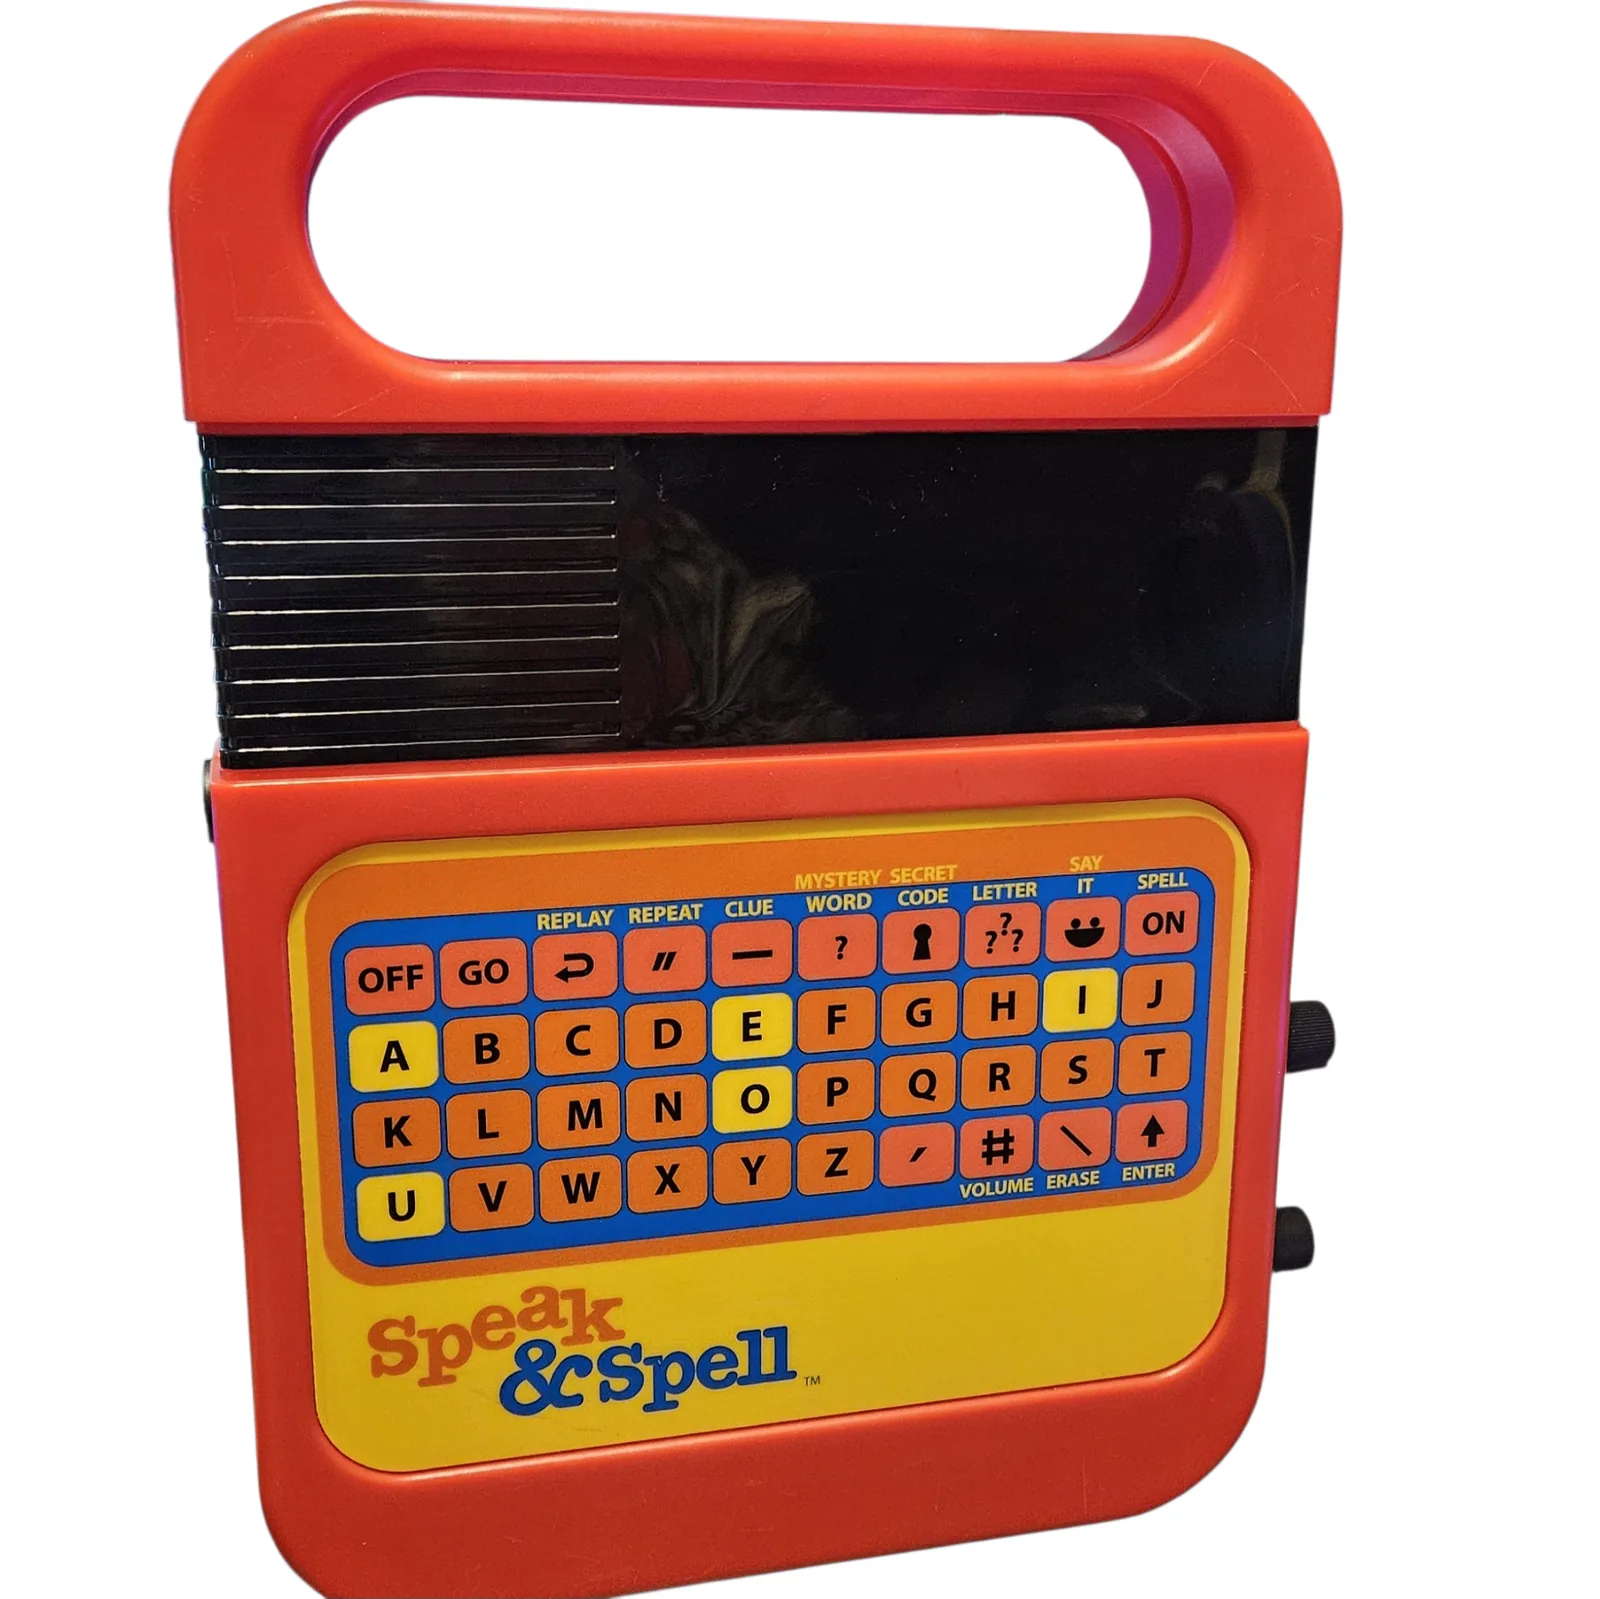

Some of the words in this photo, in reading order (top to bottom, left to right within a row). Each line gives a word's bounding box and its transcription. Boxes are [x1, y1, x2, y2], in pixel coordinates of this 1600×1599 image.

[1069, 855, 1103, 872] SAY
[795, 870, 881, 890] MYSTERY
[890, 865, 957, 883] SECRET
[1137, 873, 1188, 890] SPELL
[972, 883, 1037, 902] LETTER
[1077, 878, 1094, 894] IT
[806, 893, 872, 913] WORD
[898, 888, 949, 906] CODE
[629, 904, 703, 923] REPEAT
[725, 900, 774, 917] CLUE
[537, 910, 614, 930] REPLAY
[1143, 911, 1184, 935] ON
[359, 965, 423, 993] OFF
[459, 959, 509, 985] GO
[380, 1041, 409, 1072] A
[475, 1033, 500, 1064] B
[566, 1025, 590, 1056] C
[654, 1019, 682, 1049] D
[743, 1011, 762, 1041] E
[828, 1004, 846, 1034] F
[906, 998, 931, 1027] G
[991, 991, 1015, 1021] H
[1079, 986, 1086, 1014] I
[1147, 980, 1162, 1008] J
[384, 1116, 412, 1148] K
[478, 1109, 499, 1139] L
[568, 1099, 602, 1131] M
[655, 1091, 681, 1122] N
[741, 1084, 769, 1113] O
[827, 1077, 848, 1107] P
[909, 1069, 936, 1101] Q
[989, 1063, 1010, 1091] R
[1069, 1055, 1087, 1084] S
[1145, 1049, 1165, 1077] T
[1046, 1171, 1100, 1189] ERASE
[1122, 1164, 1175, 1181] ENTER
[388, 1190, 415, 1221] U
[478, 1181, 506, 1212] V
[562, 1172, 600, 1204] W
[656, 1164, 680, 1195] X
[741, 1155, 765, 1185] Y
[825, 1147, 848, 1177] Z
[959, 1178, 1034, 1199] VOLUME
[367, 1285, 626, 1387] Speak
[598, 1326, 797, 1412] Spell
